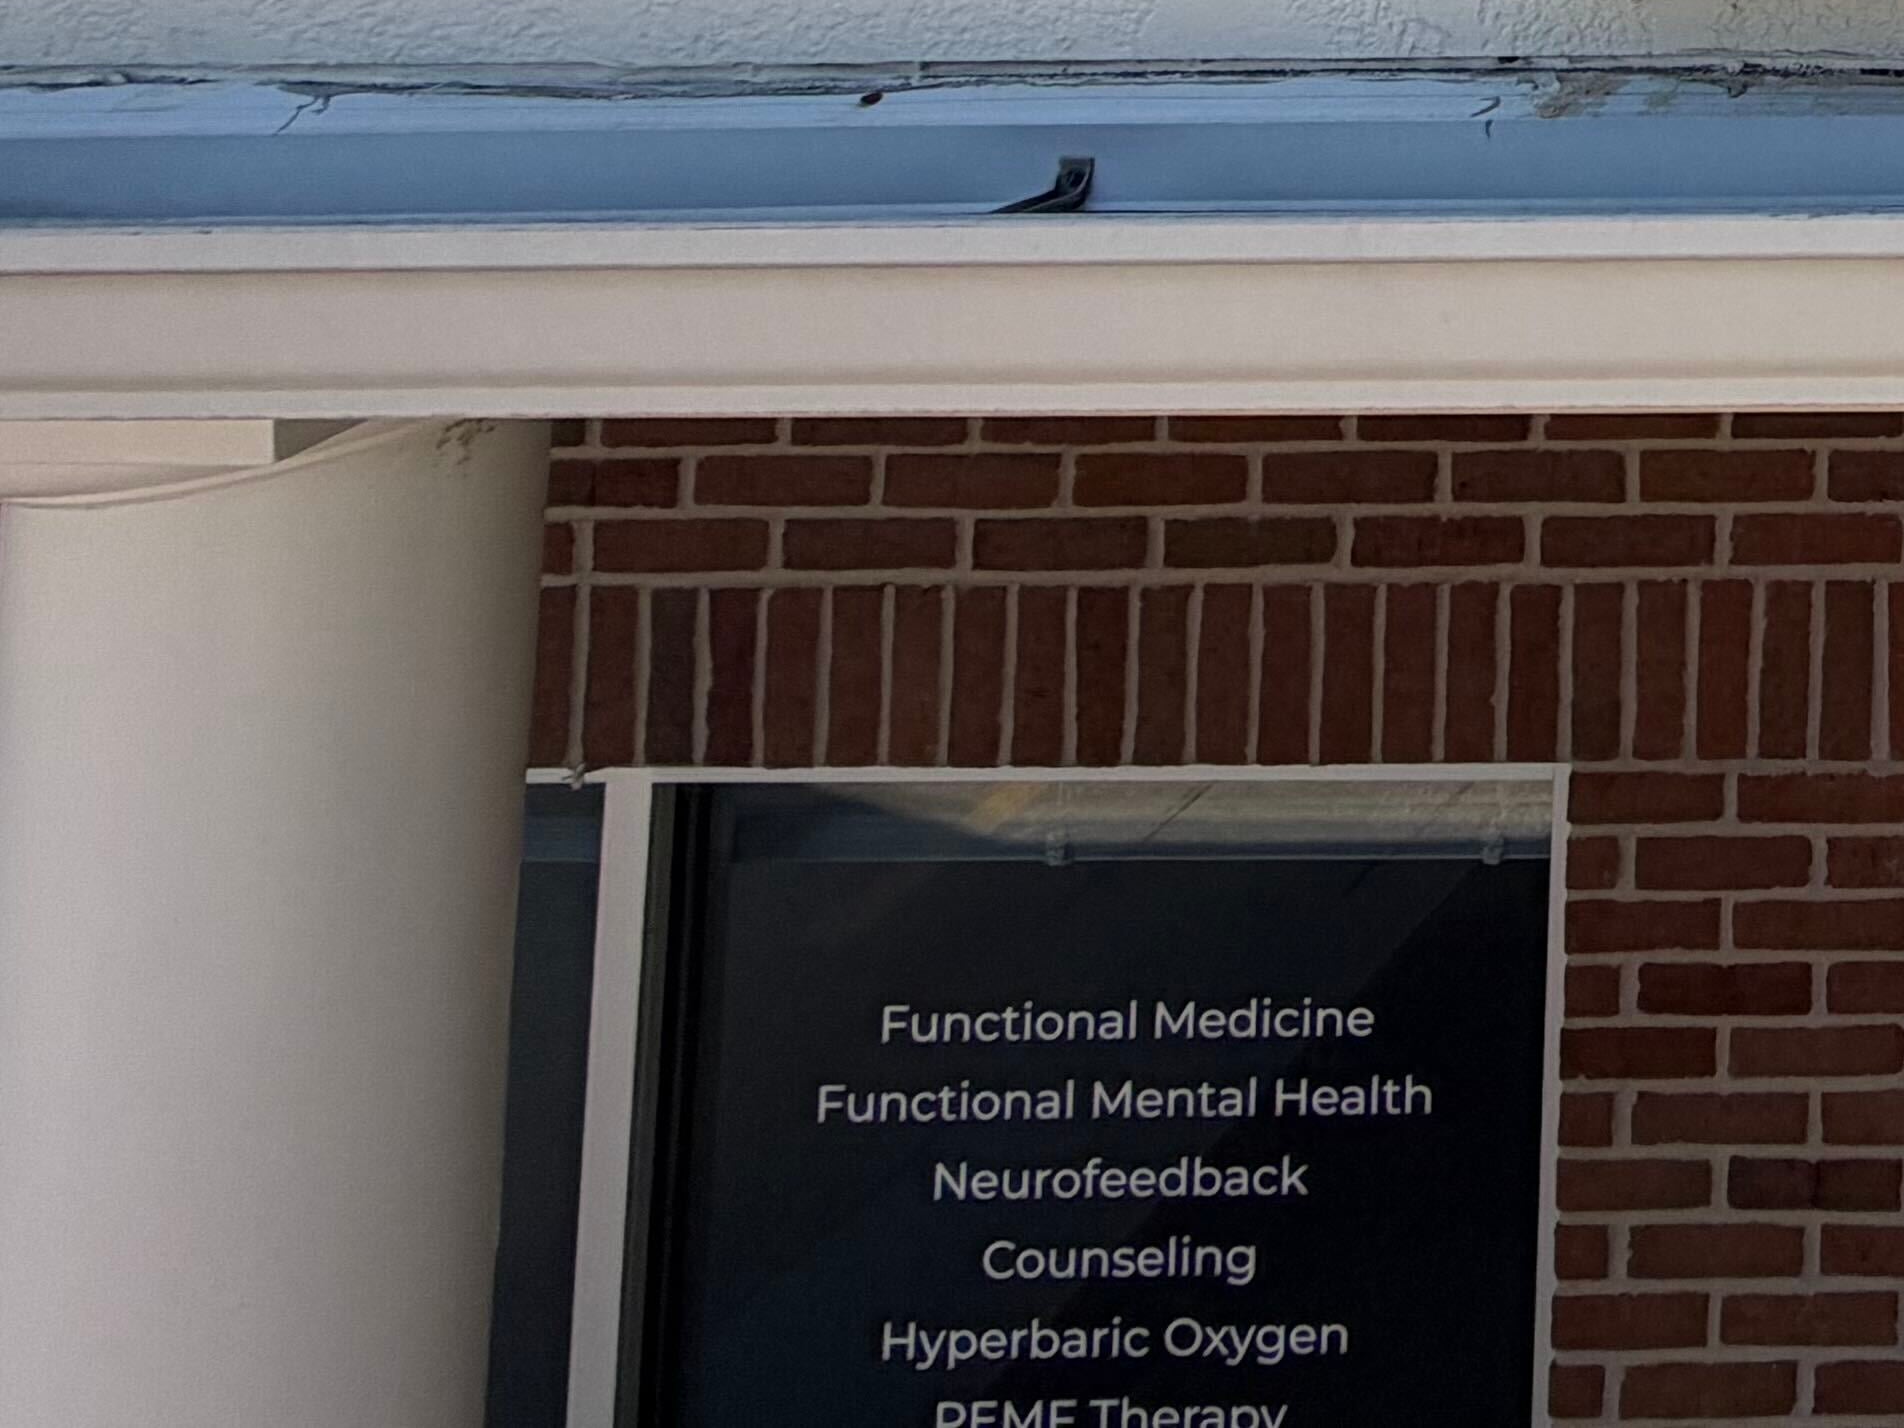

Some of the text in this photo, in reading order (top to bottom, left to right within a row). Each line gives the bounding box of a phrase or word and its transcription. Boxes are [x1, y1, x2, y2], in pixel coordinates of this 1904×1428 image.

[881, 997, 1375, 1043] Functional Medicine
[817, 1075, 1433, 1123] Functional Mental Health
[934, 1155, 1308, 1201] Neurofeedback
[982, 1235, 1256, 1285] Counseling
[882, 1316, 1348, 1370] Hyperbaric Oxygen
